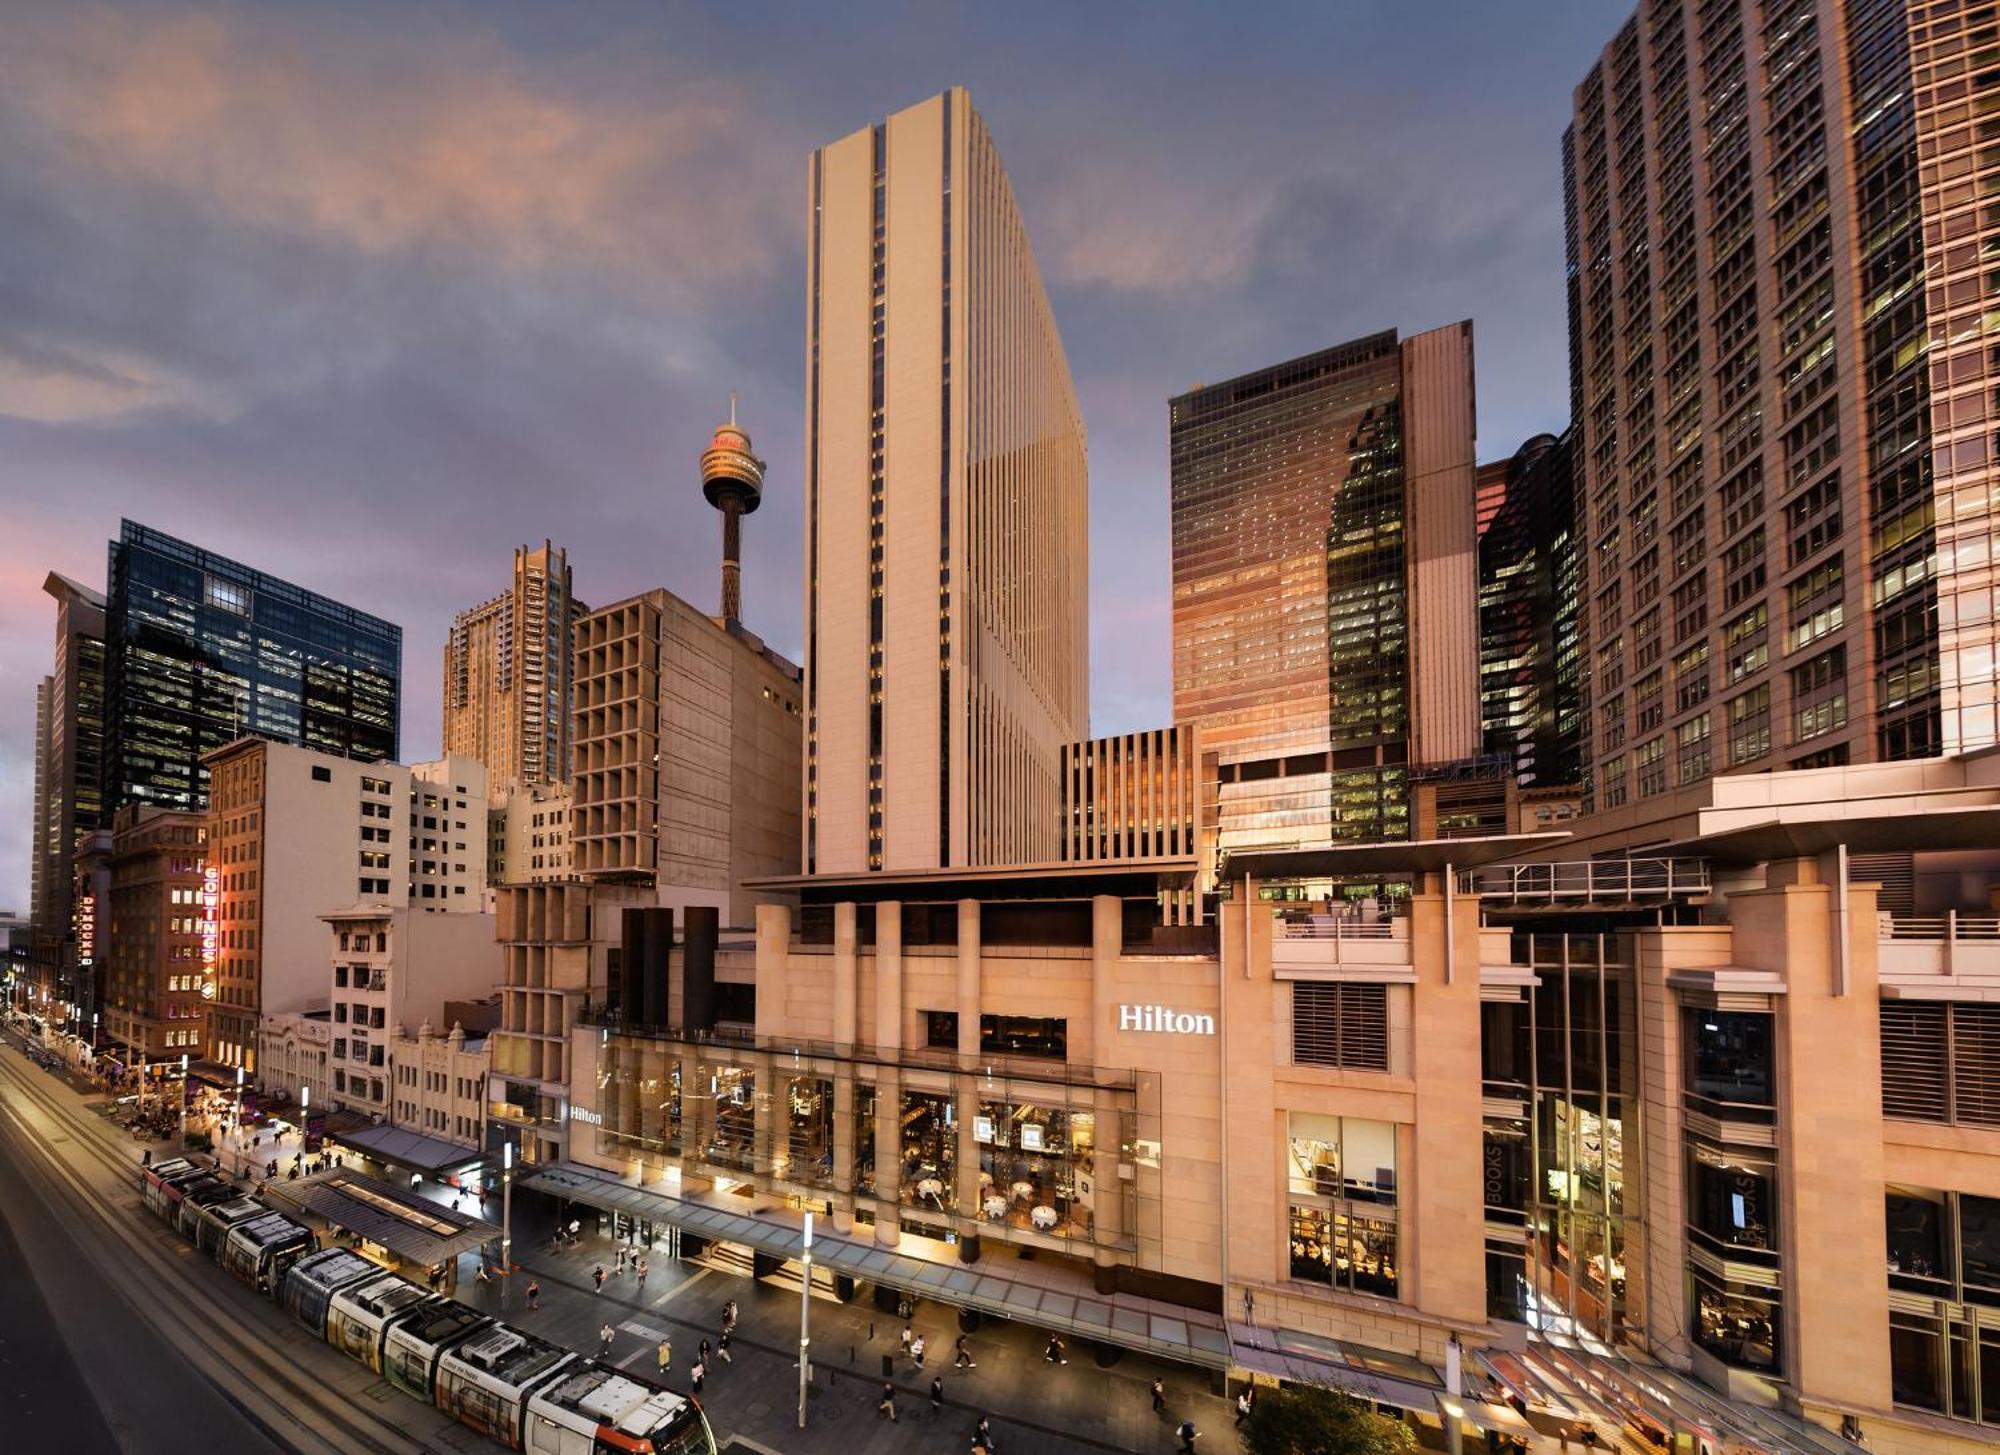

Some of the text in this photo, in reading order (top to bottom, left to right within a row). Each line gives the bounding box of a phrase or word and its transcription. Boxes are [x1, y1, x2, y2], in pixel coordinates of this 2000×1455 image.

[82, 896, 95, 957] DYMOCKS
[202, 867, 217, 963] GOWINGS
[1120, 1004, 1215, 1035] Hilton
[570, 1105, 602, 1125] Hilton
[1486, 1146, 1503, 1203] BOOKS
